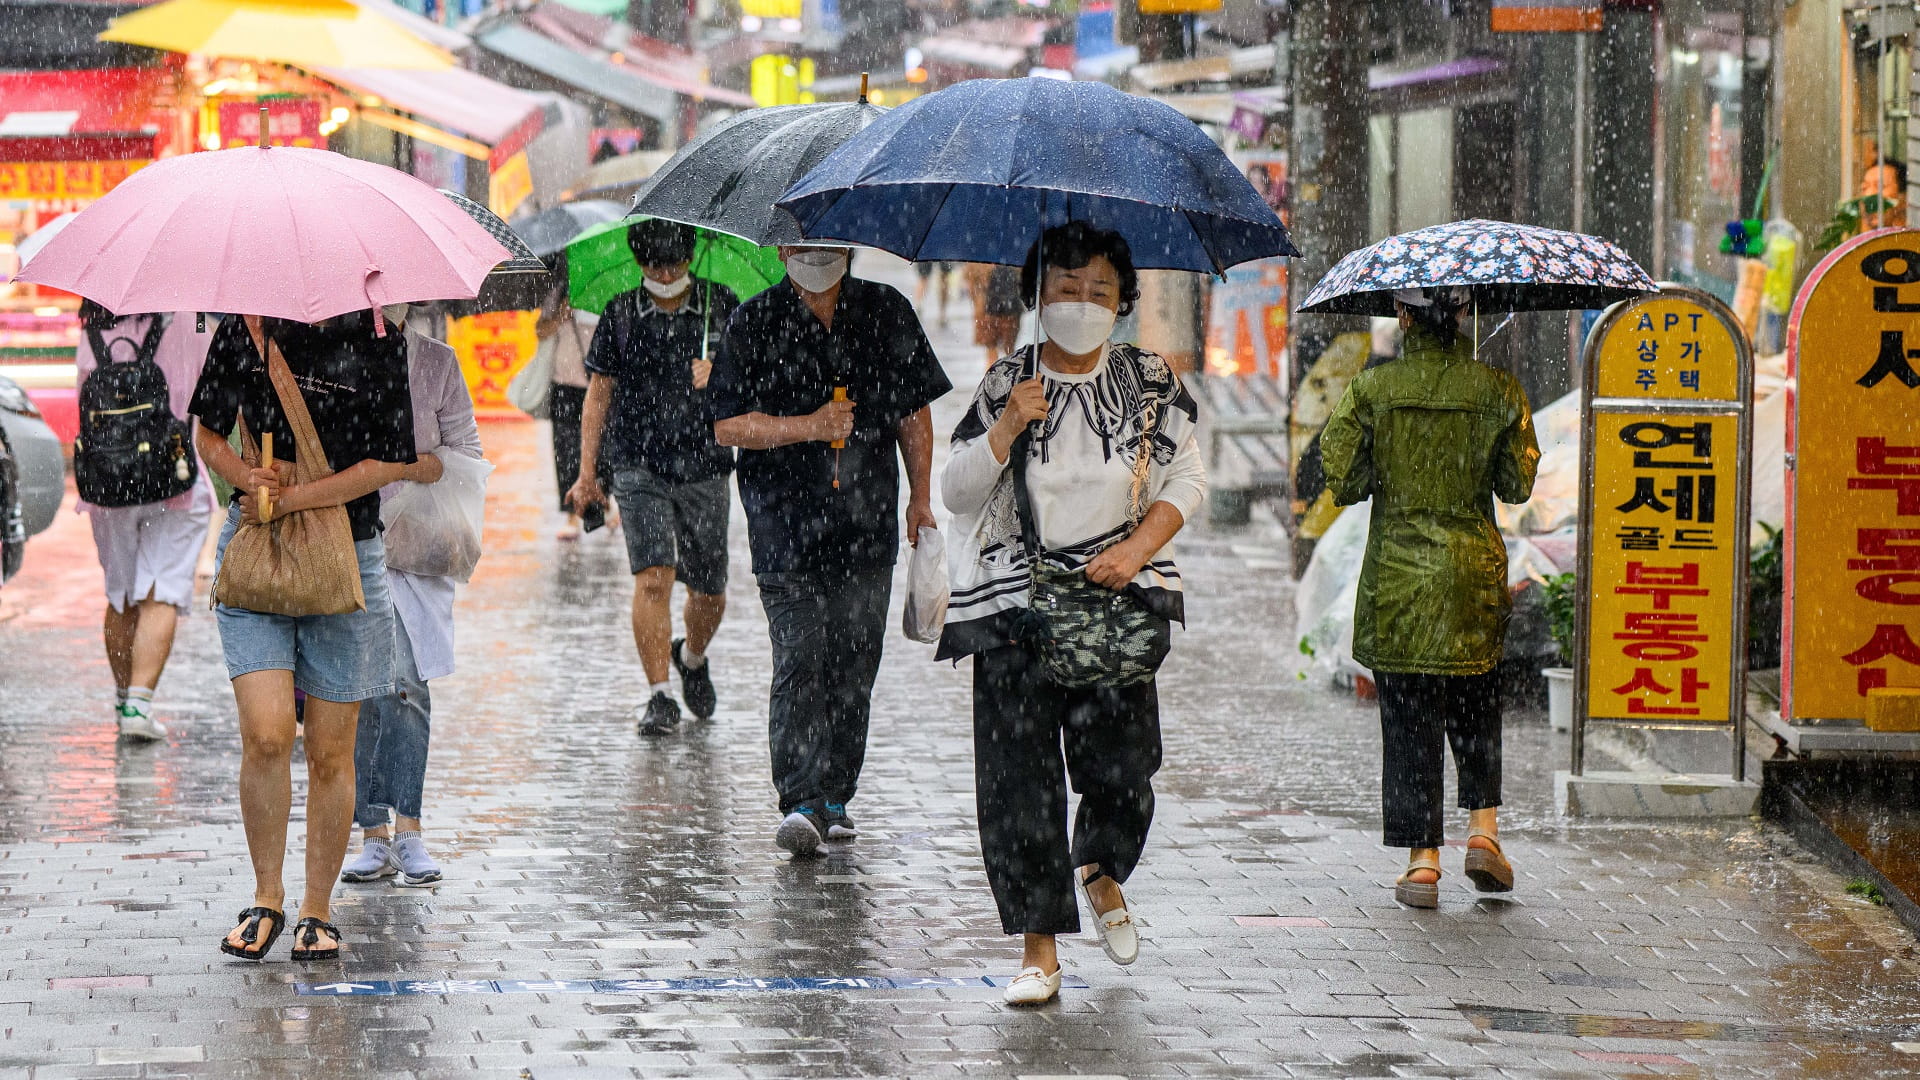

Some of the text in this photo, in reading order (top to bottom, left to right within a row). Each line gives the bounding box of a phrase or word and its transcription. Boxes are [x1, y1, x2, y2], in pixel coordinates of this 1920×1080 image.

[1637, 313, 1703, 332] APT
[1636, 340, 1703, 363] 상가
[1635, 369, 1700, 392] 주택
[1615, 422, 1717, 523] 연세
[1615, 526, 1718, 550] 골드
[1611, 561, 1710, 715] 부동산
